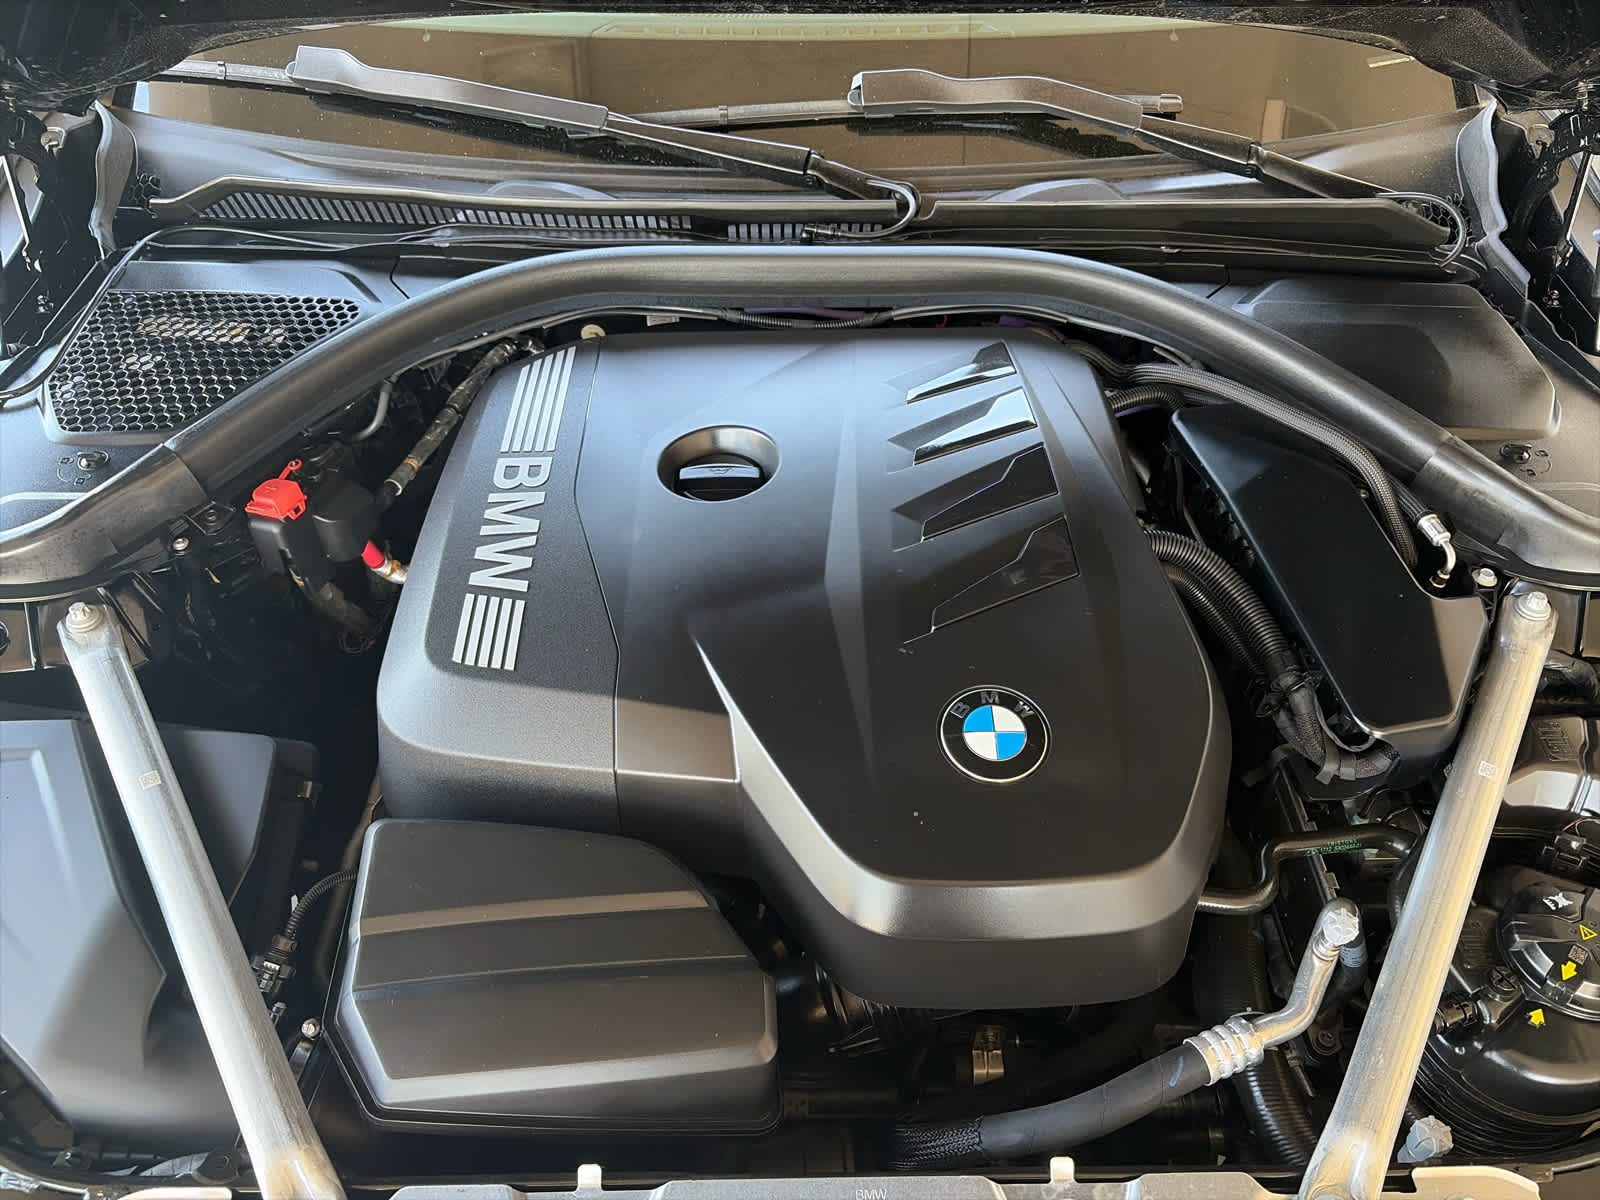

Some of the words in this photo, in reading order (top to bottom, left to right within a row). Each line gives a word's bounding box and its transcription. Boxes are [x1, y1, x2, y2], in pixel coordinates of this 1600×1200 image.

[468, 456, 553, 592] BMW
[950, 690, 1035, 719] BMW
[855, 1188, 888, 1200] BMW
